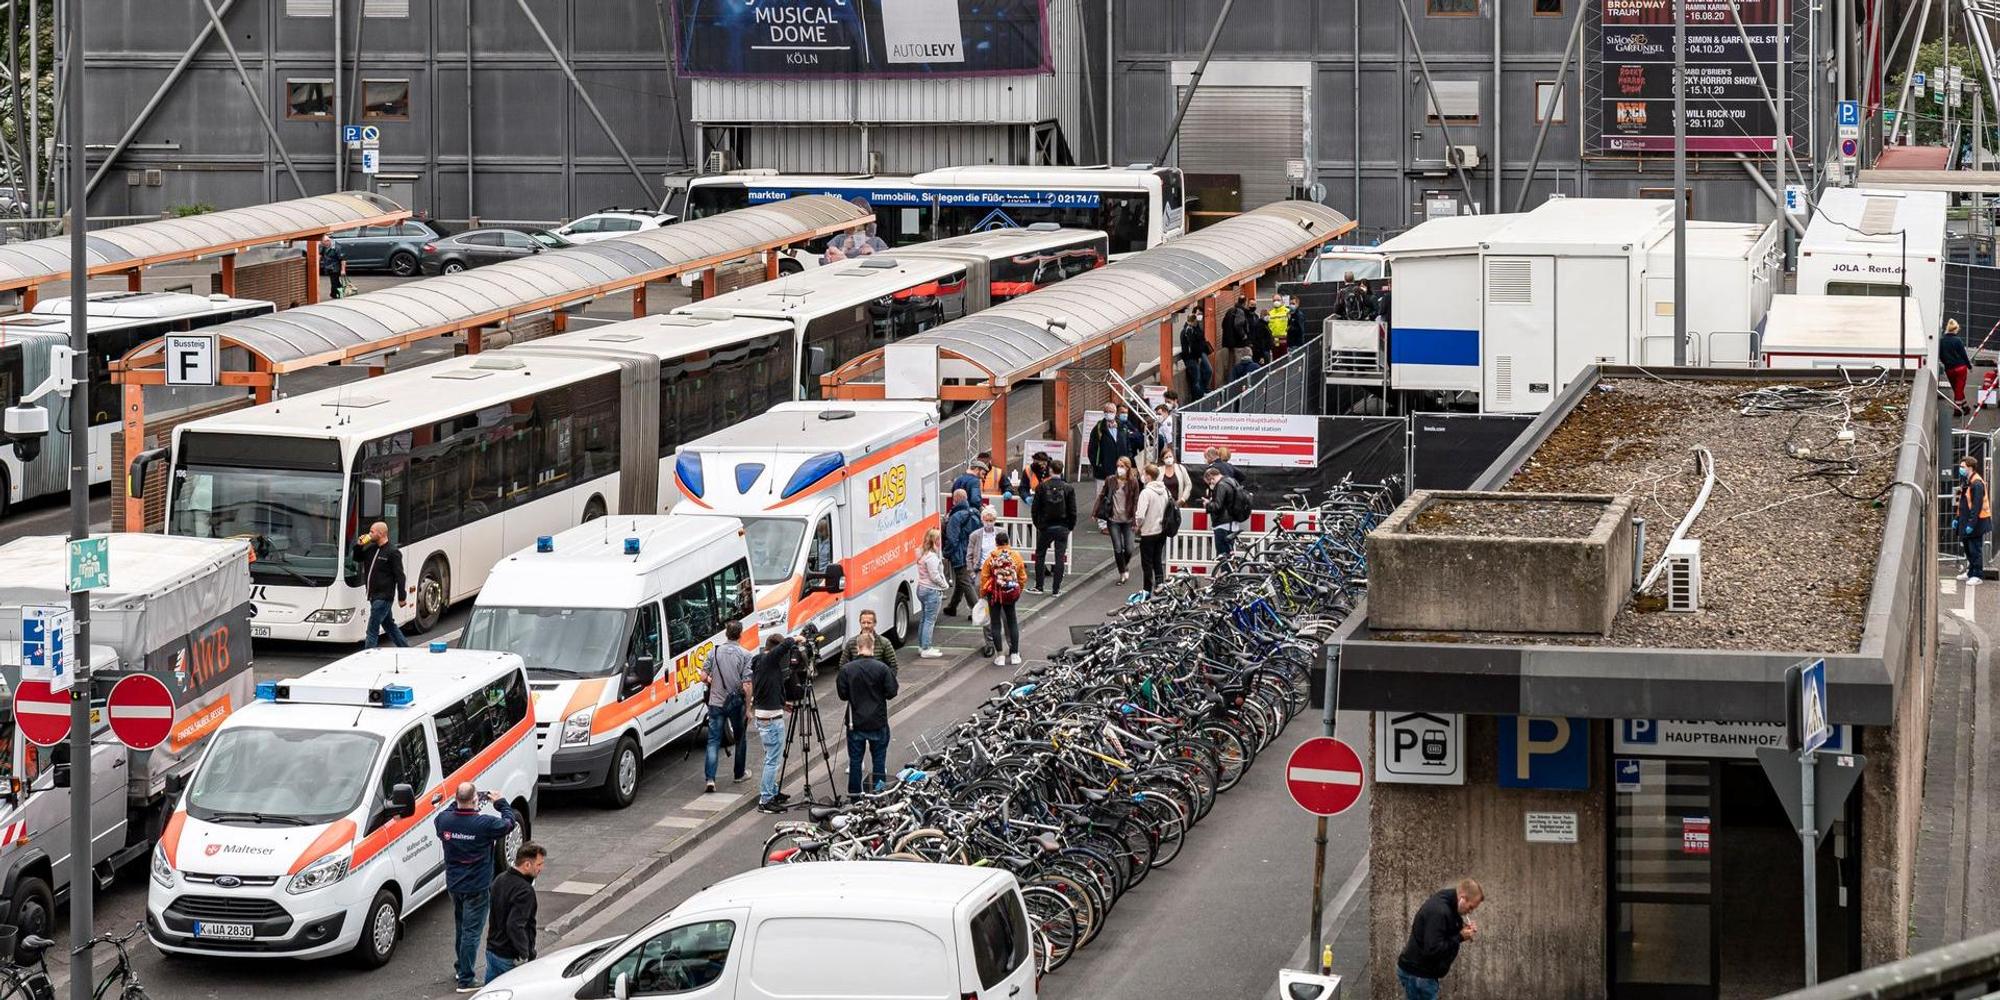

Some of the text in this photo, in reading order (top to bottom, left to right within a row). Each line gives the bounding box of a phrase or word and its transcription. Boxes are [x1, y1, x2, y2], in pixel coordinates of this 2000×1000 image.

[1607, 0, 1666, 9] BROADWAY
[755, 7, 838, 24] MUSICAL
[1607, 8, 1640, 16] TRAUM
[770, 25, 828, 42] DOME
[1688, 36, 1712, 44] SIMON
[1714, 36, 1720, 44] &
[1766, 36, 1790, 44] STOY
[892, 43, 956, 58] AUTOLEVY
[1690, 45, 1725, 54] 04.10.20
[786, 52, 819, 64] KÖLN
[1672, 77, 1758, 85] RCKY HORROR SHOW
[1691, 86, 1725, 95] 15.11.20
[1686, 110, 1705, 118] WILL
[1707, 110, 1729, 118] ROCK
[1730, 110, 1746, 118] YOU
[1690, 119, 1725, 128] 29.11.20
[748, 190, 787, 200] markten
[871, 192, 919, 203] Immobilie,
[965, 193, 981, 202] die
[1832, 263, 1859, 272] JOLA
[173, 339, 206, 349] Bussteig
[180, 351, 199, 380] F
[880, 463, 908, 509] ASB
[190, 624, 231, 689] AWB
[1394, 728, 1419, 762] P
[1516, 715, 1571, 779] P
[452, 832, 476, 840] Malteser
[223, 844, 275, 855] Malteser
[212, 925, 225, 937] UA
